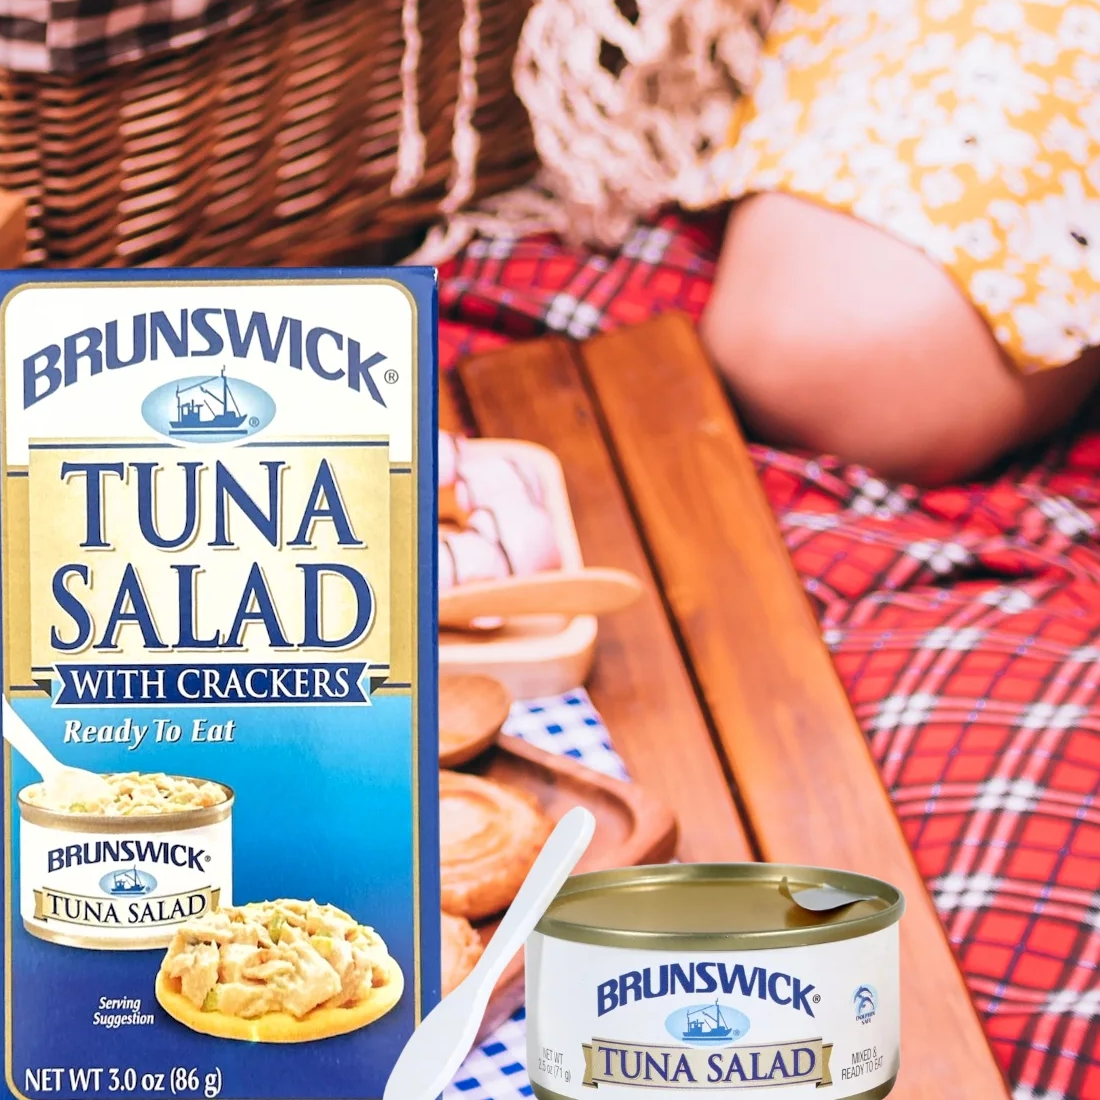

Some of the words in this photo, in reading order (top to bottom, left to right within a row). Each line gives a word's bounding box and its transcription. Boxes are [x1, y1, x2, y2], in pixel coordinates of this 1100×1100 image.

[22, 308, 388, 410] BRUNSWICK
[60, 458, 363, 550] TUNA
[50, 561, 376, 652] SALAD
[69, 669, 166, 699] WITH
[176, 668, 350, 699] CRACKERS
[63, 718, 148, 750] Ready
[153, 719, 182, 743] To
[190, 719, 236, 742] Eat
[48, 840, 206, 873] BRUNSWICK
[47, 893, 123, 924] TUNA
[128, 894, 207, 924] SALAD
[99, 996, 141, 1012] Serving
[597, 962, 816, 1018] BRUNSWICK
[93, 1011, 155, 1028] Suggestion
[543, 1047, 553, 1061] NET
[554, 1051, 564, 1065] WT
[598, 1046, 698, 1082] TUNA
[707, 1048, 816, 1083] SALAD
[841, 1063, 864, 1080] READY
[866, 1060, 874, 1074] TO
[875, 1055, 884, 1070] EAT
[852, 1048, 871, 1065] MIXED
[872, 1046, 877, 1058] &
[25, 1068, 64, 1091] NET
[69, 1068, 103, 1091] WT
[108, 1068, 137, 1091] 3.0
[141, 1073, 165, 1091] oz
[170, 1067, 199, 1095] (86
[204, 1067, 222, 1098] g)
